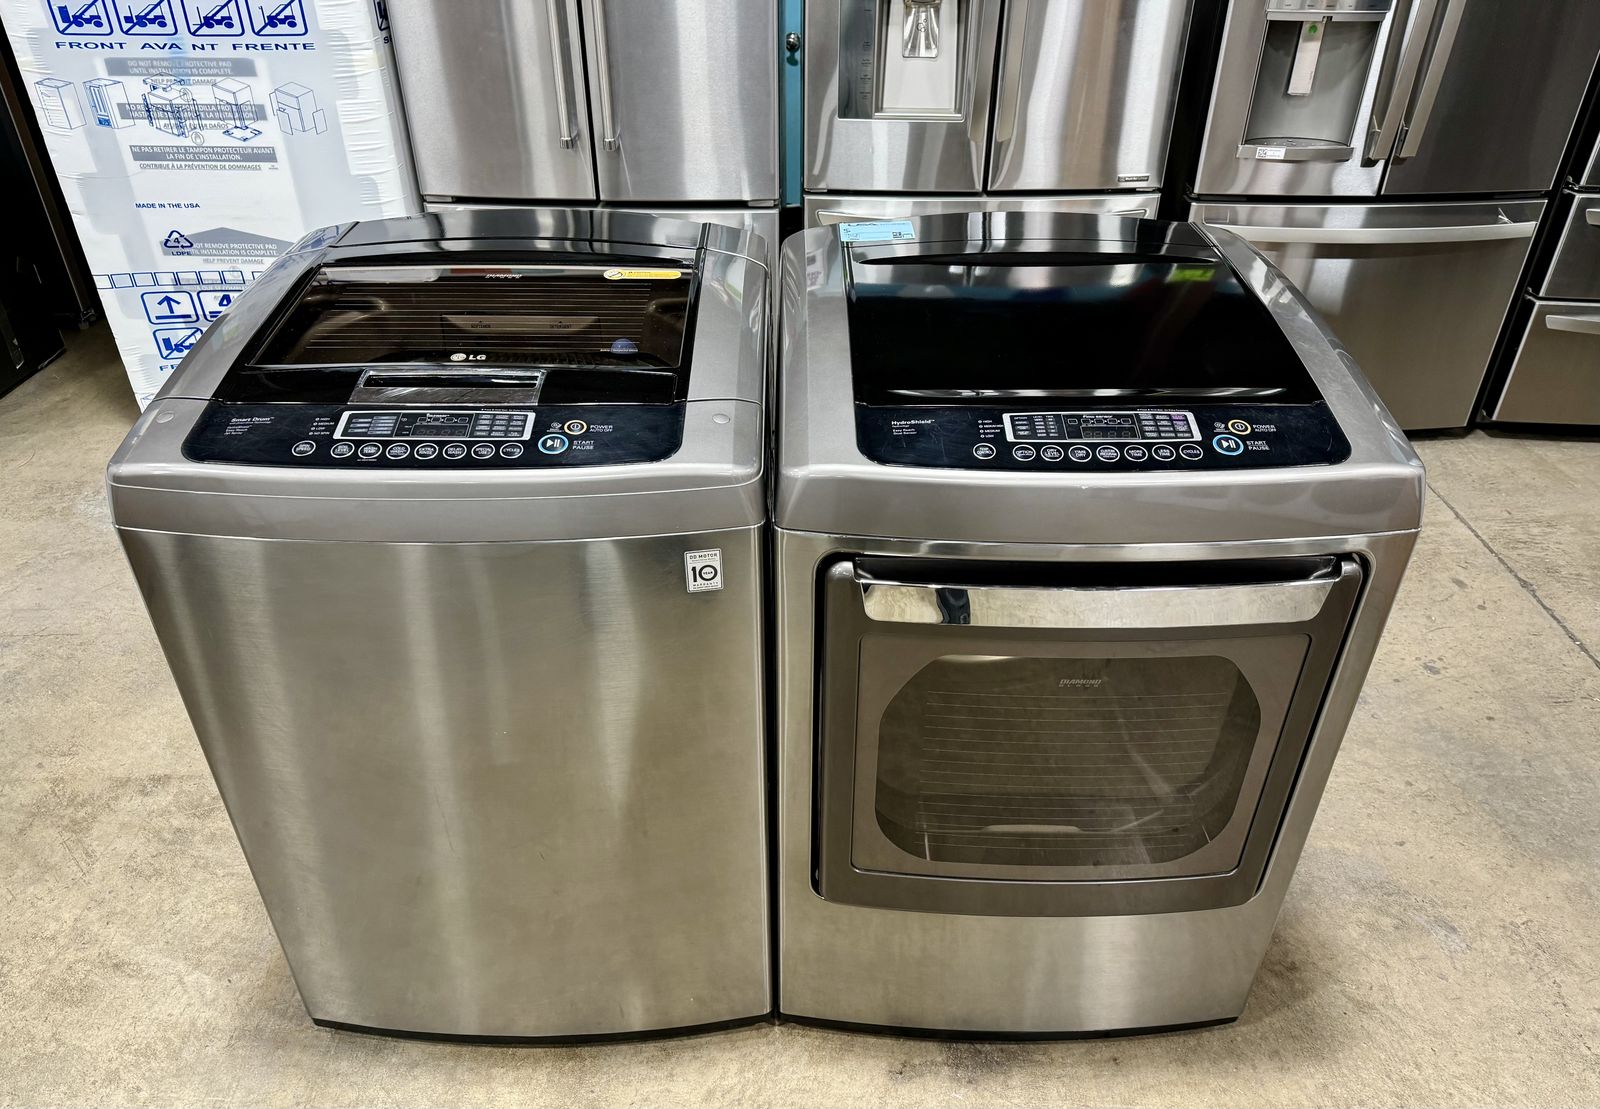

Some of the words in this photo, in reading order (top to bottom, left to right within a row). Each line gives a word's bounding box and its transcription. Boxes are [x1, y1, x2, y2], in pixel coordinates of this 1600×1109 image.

[55, 41, 127, 50] FRONT
[231, 42, 316, 51] FRENTE
[691, 564, 718, 582] 10
